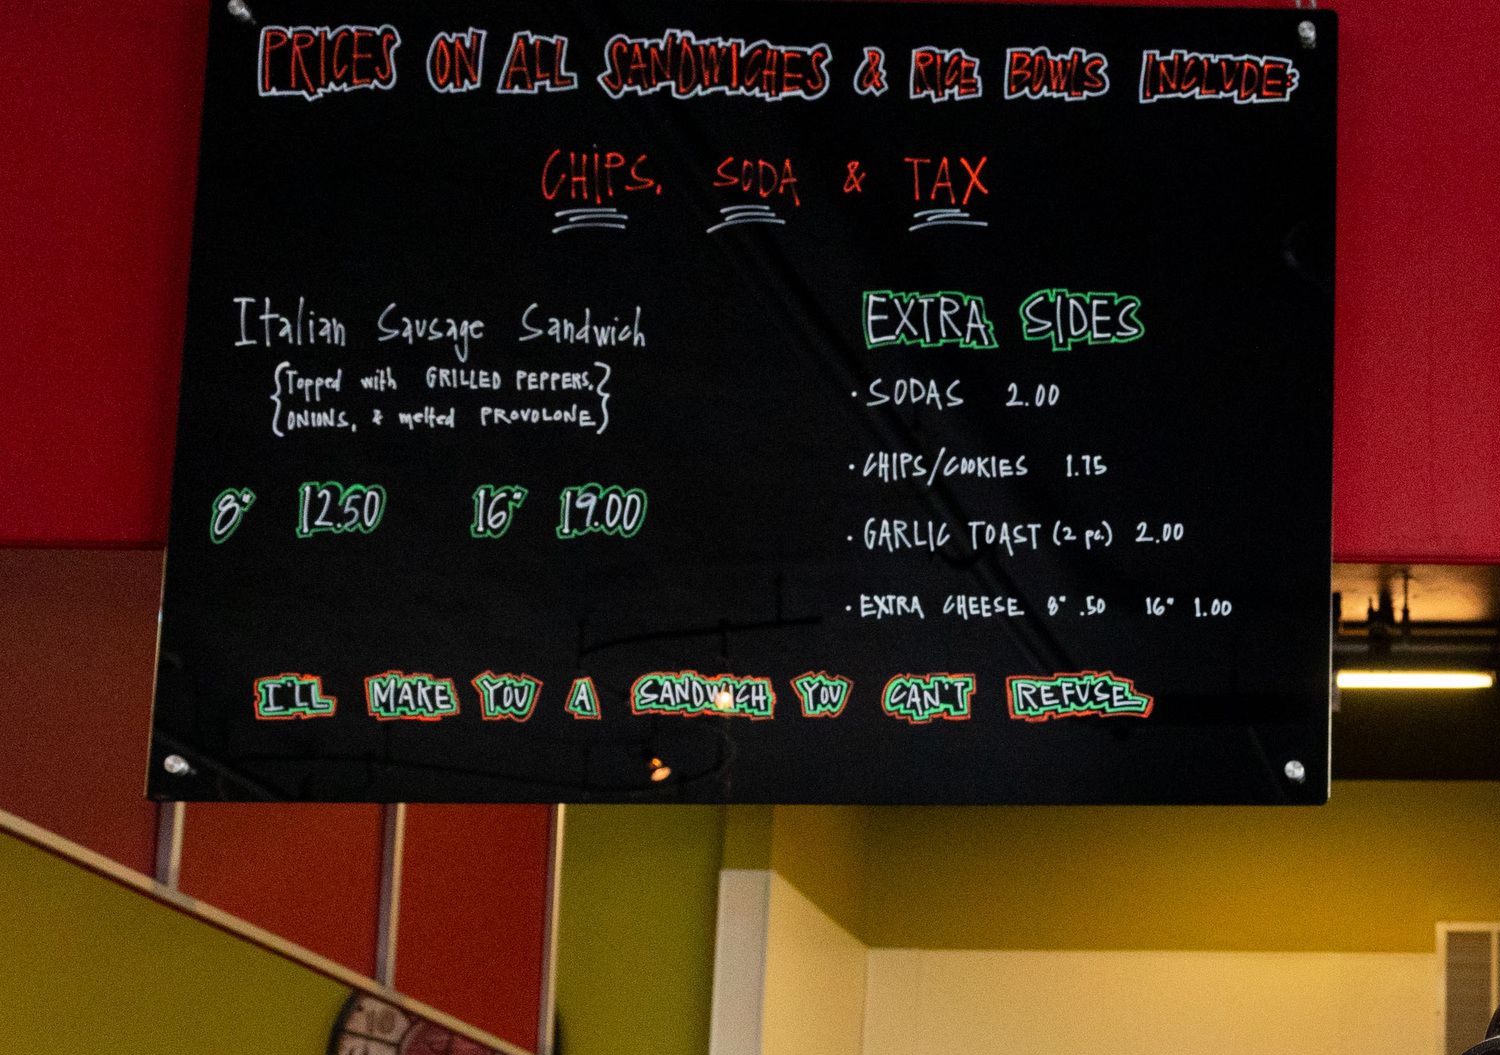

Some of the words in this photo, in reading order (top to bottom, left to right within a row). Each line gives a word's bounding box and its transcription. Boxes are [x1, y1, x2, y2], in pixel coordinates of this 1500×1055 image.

[263, 29, 398, 94] PRICES
[432, 32, 482, 90] ON
[505, 35, 573, 89] ALL
[604, 35, 828, 97] SANDWICHES
[863, 50, 887, 92] &
[914, 49, 979, 97] RICE
[1008, 49, 1104, 98] BOWLS
[1143, 52, 1296, 100] INCLUDE:
[713, 157, 800, 206] SODA
[843, 160, 866, 193] &
[904, 156, 989, 205] TAX
[234, 296, 346, 348] Italian
[377, 302, 484, 362] Sausage
[518, 302, 646, 348] Sandwich
[867, 294, 993, 347] EXTRA
[1023, 294, 1143, 347] SIDES
[361, 366, 397, 391] with
[426, 365, 501, 391] GRILLED
[867, 379, 964, 410] SODAS
[1006, 383, 1060, 406] 2.00
[372, 410, 384, 426] &
[399, 405, 455, 429] melted
[862, 447, 1028, 485] CHIPS/COOKIES
[1066, 455, 1108, 477] 1.75
[214, 492, 253, 536] 8"
[301, 485, 382, 535] 12.50
[474, 487, 525, 534] 16"
[561, 489, 643, 535] 19.00
[863, 517, 950, 552] GARLIC
[968, 521, 1041, 556] TOAST
[1053, 521, 1077, 546] (2
[1136, 522, 1185, 544] 2.00
[861, 594, 924, 620] EXTRA
[943, 595, 1025, 620] CHEESE
[1047, 595, 1067, 617] 8"
[1080, 597, 1106, 616] .50
[1146, 596, 1174, 617] 16"
[1194, 598, 1232, 618] 1.00
[261, 680, 330, 713] I'LL
[372, 679, 453, 713] MAKE
[481, 680, 534, 713] YOU
[573, 684, 596, 711] A
[636, 677, 769, 714] SANDWICH
[800, 679, 846, 709] YOU
[889, 680, 971, 716] CAN'T
[1015, 680, 1143, 711] REFUSE
